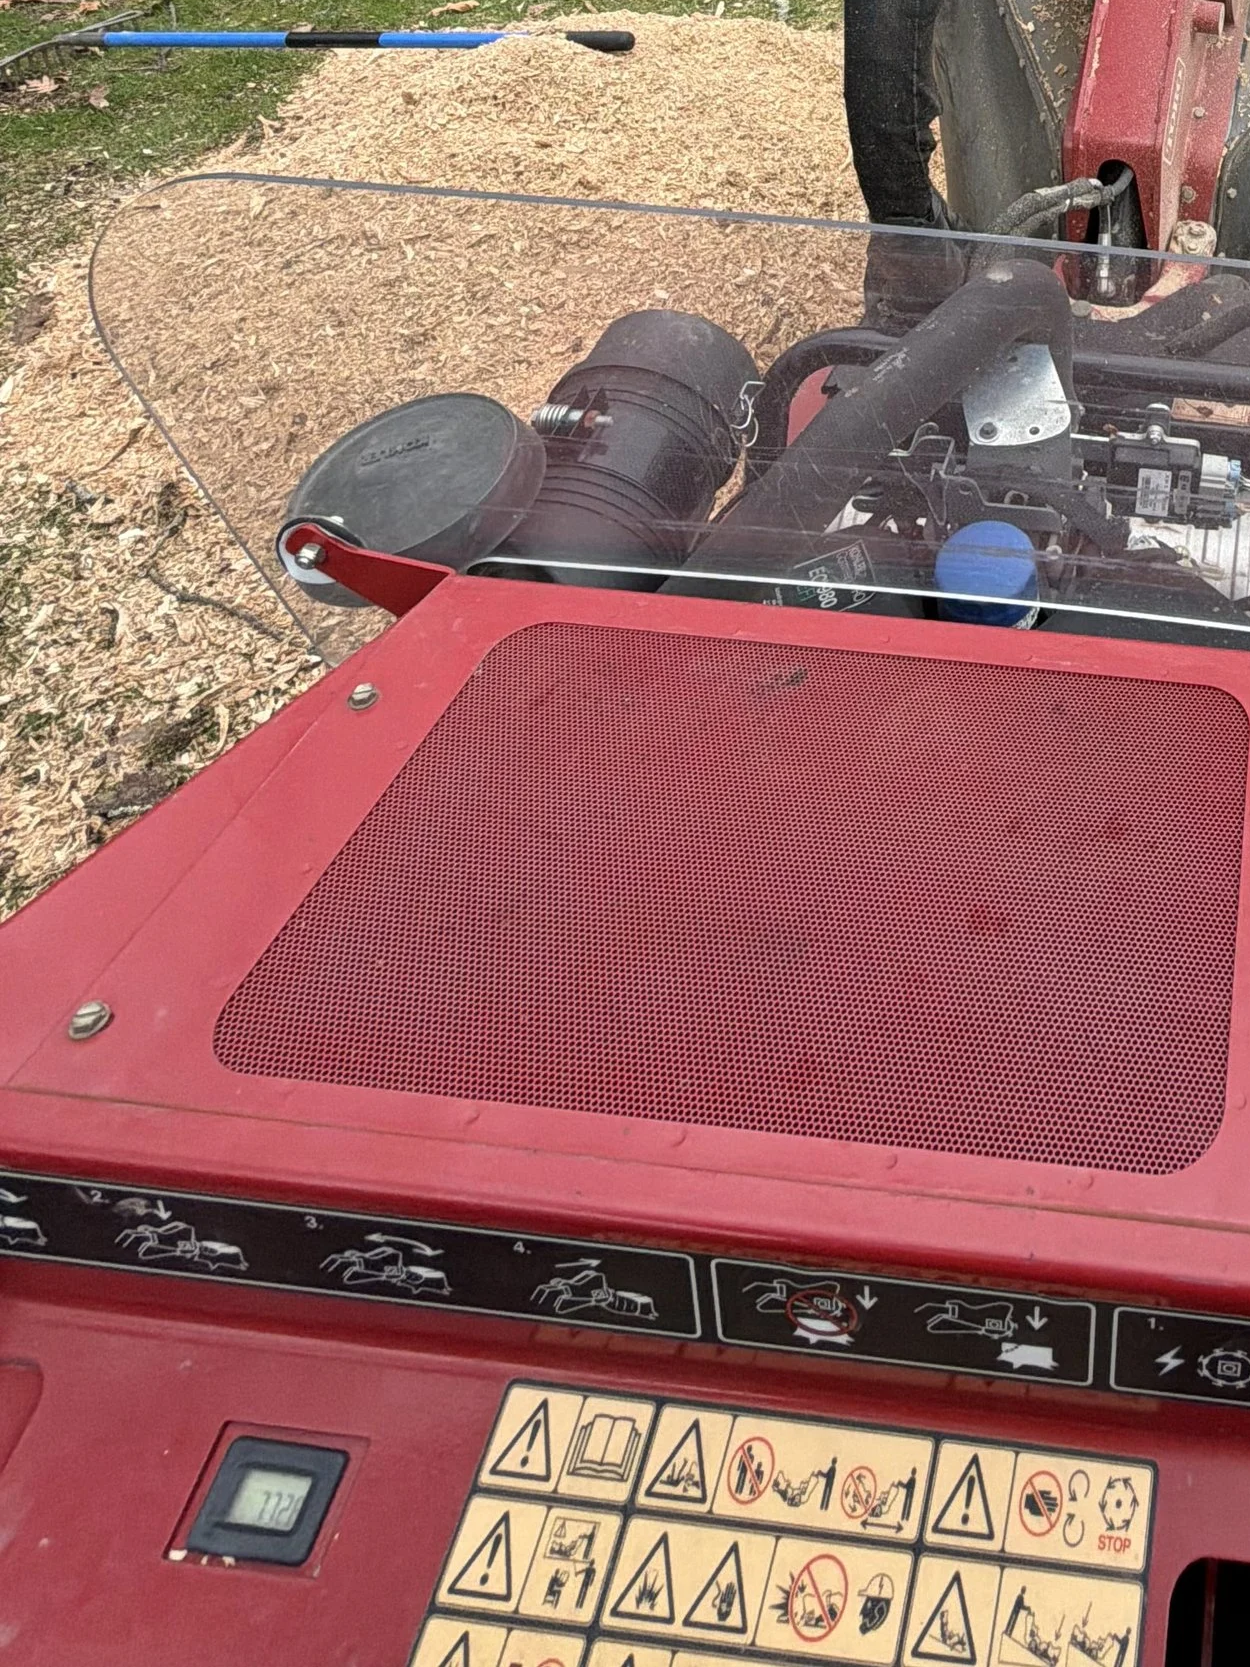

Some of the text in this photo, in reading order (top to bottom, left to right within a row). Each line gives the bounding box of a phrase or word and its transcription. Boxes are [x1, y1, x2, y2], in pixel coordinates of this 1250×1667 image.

[89, 1189, 112, 1204] 2.
[304, 1215, 325, 1230] 3.
[512, 1240, 532, 1255] 4.
[1147, 1317, 1165, 1331] 1.
[1097, 1534, 1132, 1553] STOP
